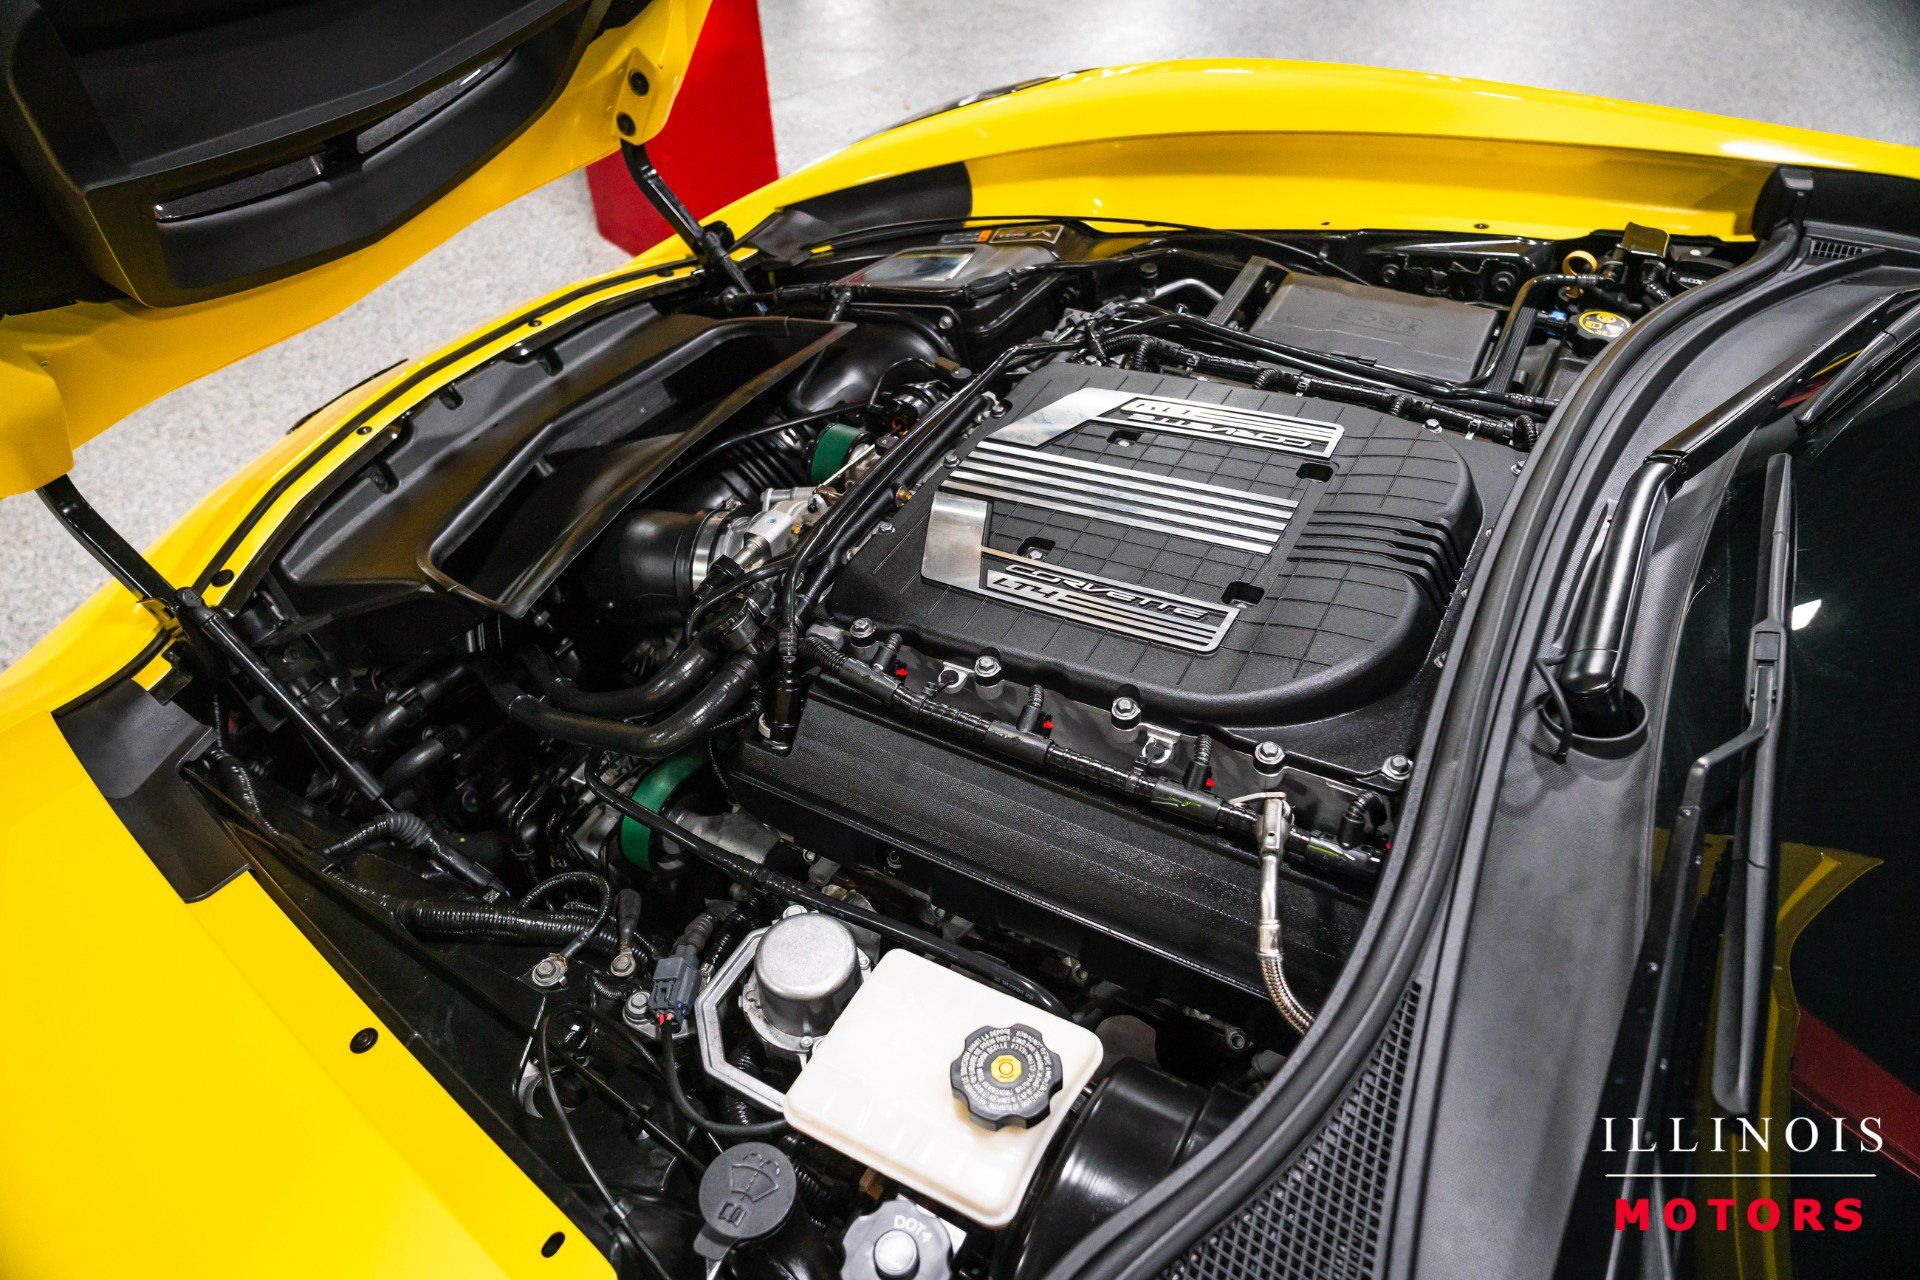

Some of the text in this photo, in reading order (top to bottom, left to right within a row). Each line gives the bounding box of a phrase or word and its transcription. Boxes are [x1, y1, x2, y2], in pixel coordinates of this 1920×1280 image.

[1126, 413, 1313, 448] CORVETTE
[992, 577, 1060, 599] LT4
[1005, 564, 1208, 620] CORVETTE
